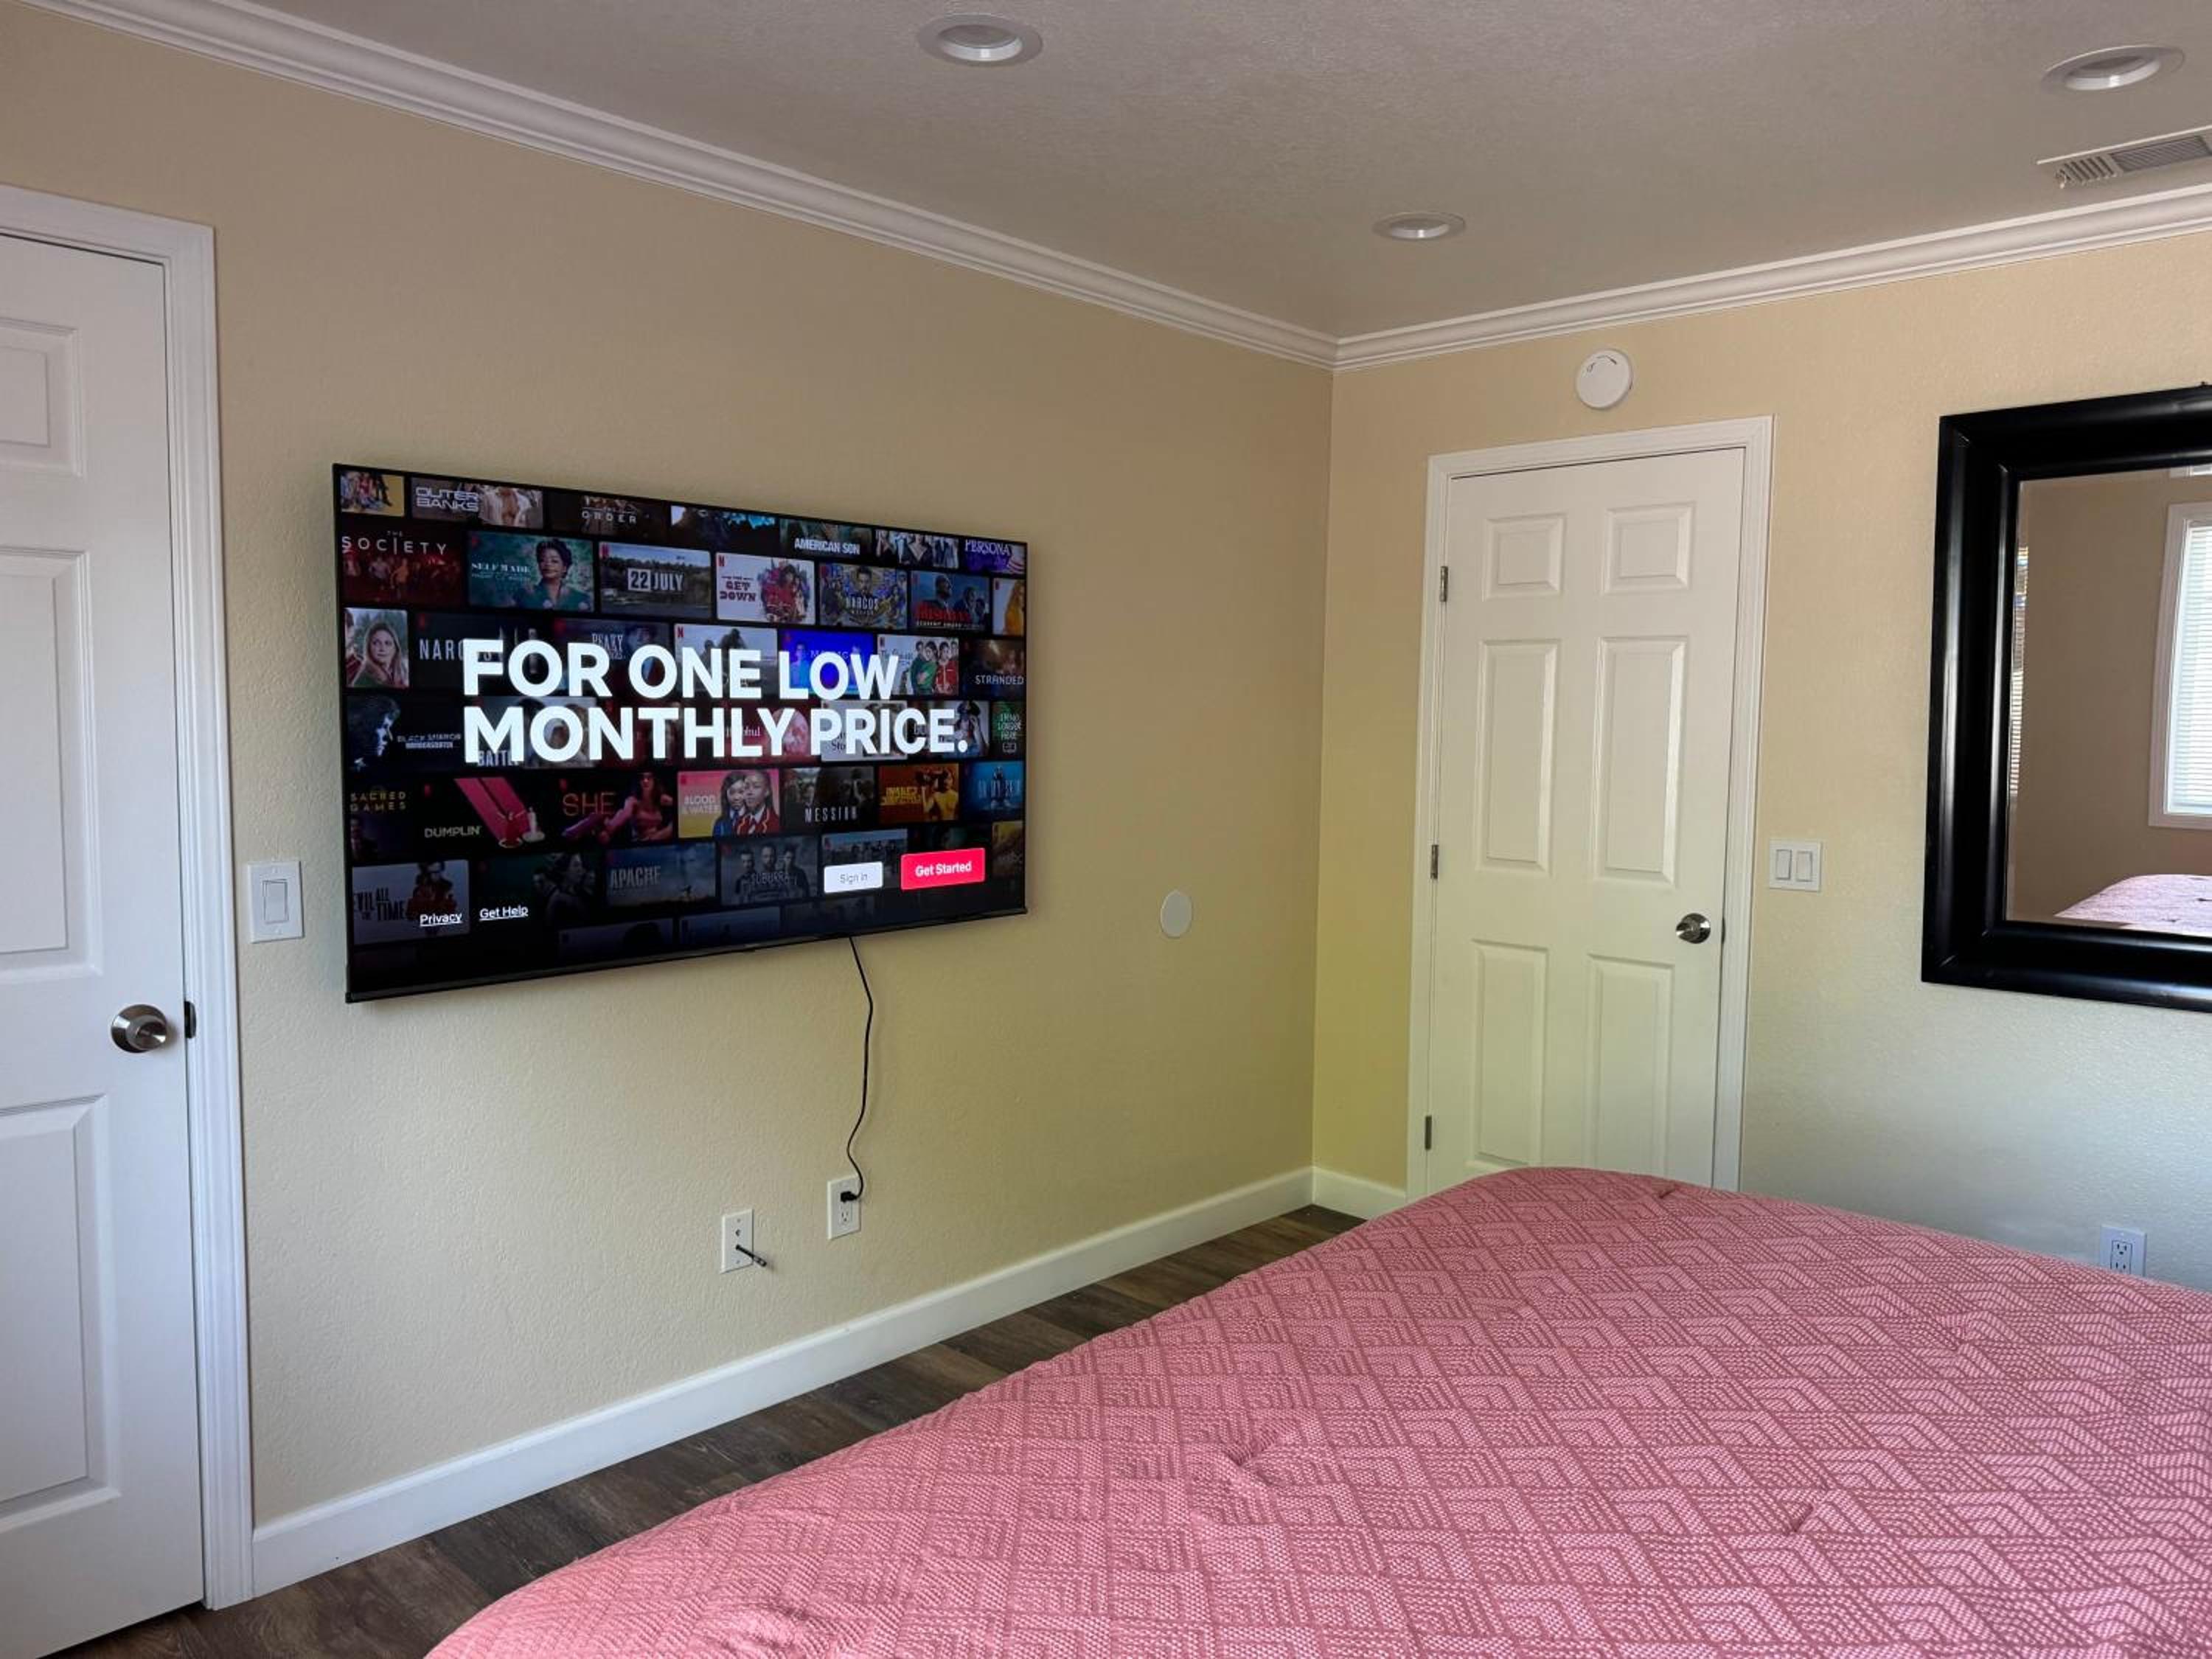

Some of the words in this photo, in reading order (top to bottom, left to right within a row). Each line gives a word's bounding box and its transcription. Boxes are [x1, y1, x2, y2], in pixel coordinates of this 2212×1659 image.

[415, 487, 479, 502] OUTER
[415, 498, 479, 512] BANKS
[581, 509, 636, 524] ORDER
[341, 536, 448, 555] SOCIETY
[794, 538, 842, 552] AMERICAN
[843, 542, 860, 555] SON
[964, 539, 1010, 557] PERSONA
[630, 571, 649, 588] 22
[652, 571, 684, 591] JULY
[726, 581, 751, 591] GET
[720, 591, 757, 602] DOWN
[463, 638, 613, 698] FOR
[628, 644, 762, 699] ONE
[778, 650, 900, 700] LOW
[974, 674, 1025, 686] STRANDED
[463, 706, 796, 763] MONTHLY
[810, 709, 969, 756] PRICE.
[349, 791, 407, 802] SACRED
[563, 792, 616, 817] SHE
[684, 796, 717, 805] BLOOD
[349, 801, 407, 812] GAMES
[610, 865, 661, 888] APACHE
[915, 863, 934, 877] Get
[935, 861, 972, 875] Started
[839, 872, 858, 885] Sign
[420, 911, 464, 927] Privacy
[480, 905, 500, 919] Get
[502, 903, 529, 918] Help
